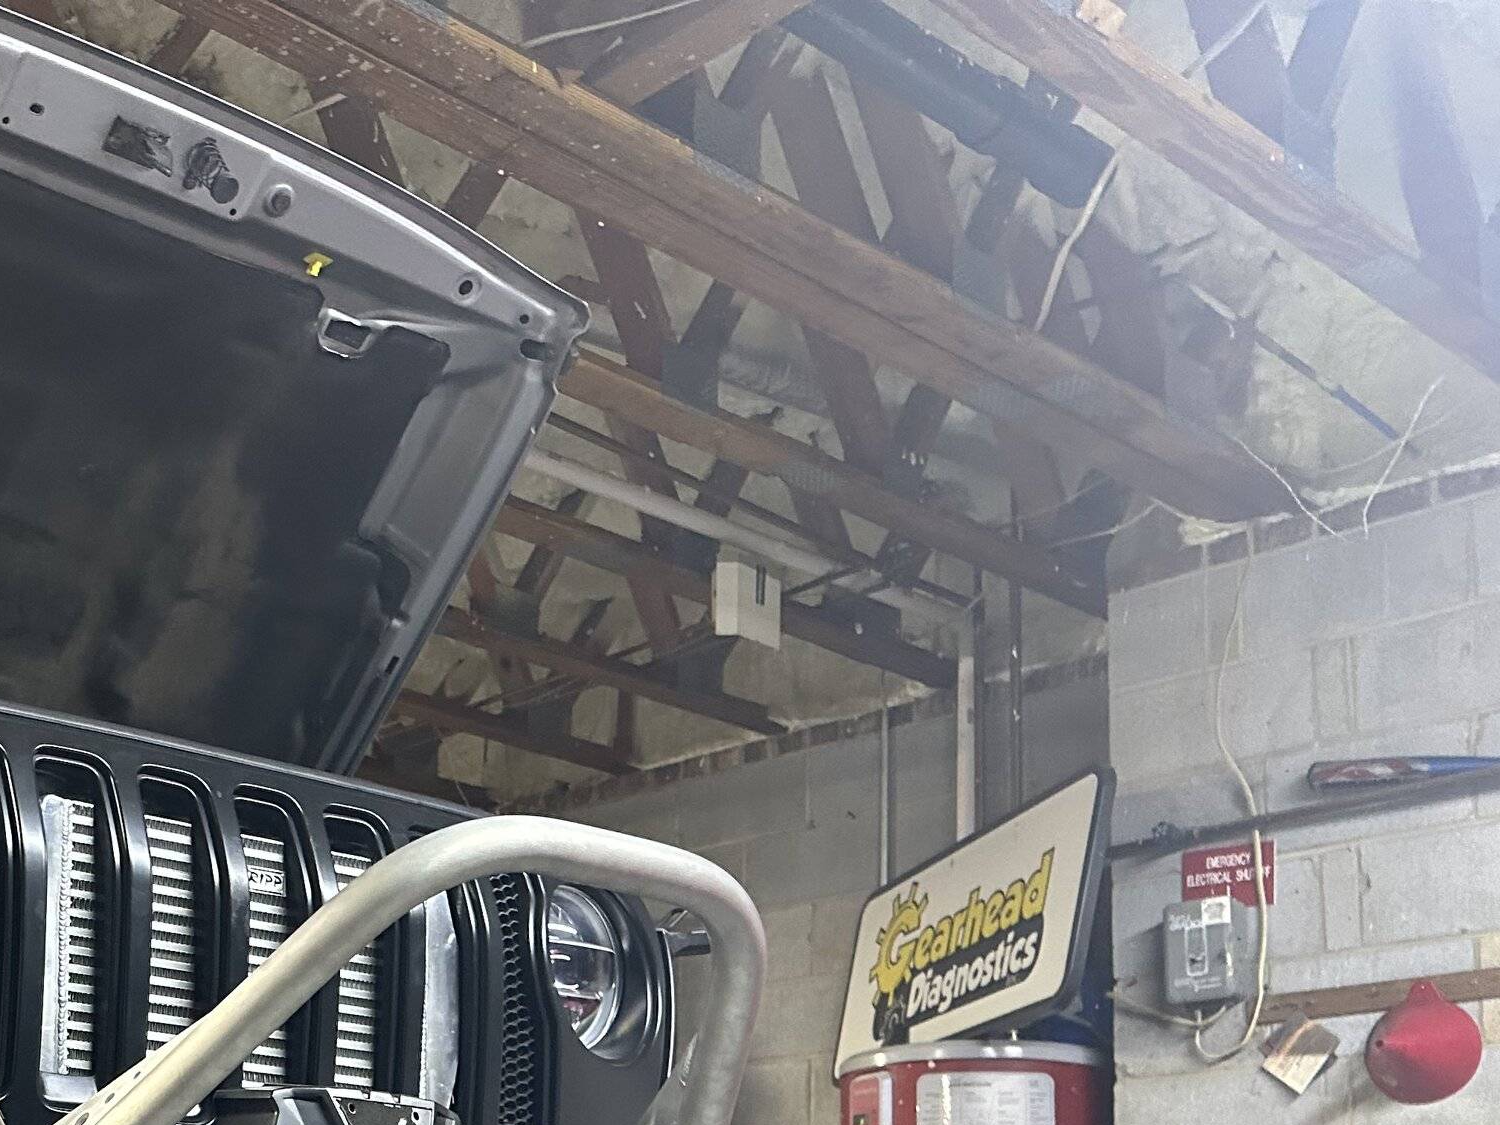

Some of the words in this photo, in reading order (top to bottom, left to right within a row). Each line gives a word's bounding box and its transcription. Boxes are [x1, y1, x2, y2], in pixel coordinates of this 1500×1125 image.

[1205, 853, 1251, 869] EMERGENCY
[248, 870, 283, 887] RIPP
[1186, 872, 1232, 887] ELECTRICAL
[869, 846, 1056, 1003] Gearhead
[905, 930, 1038, 1019] Diagnostics
